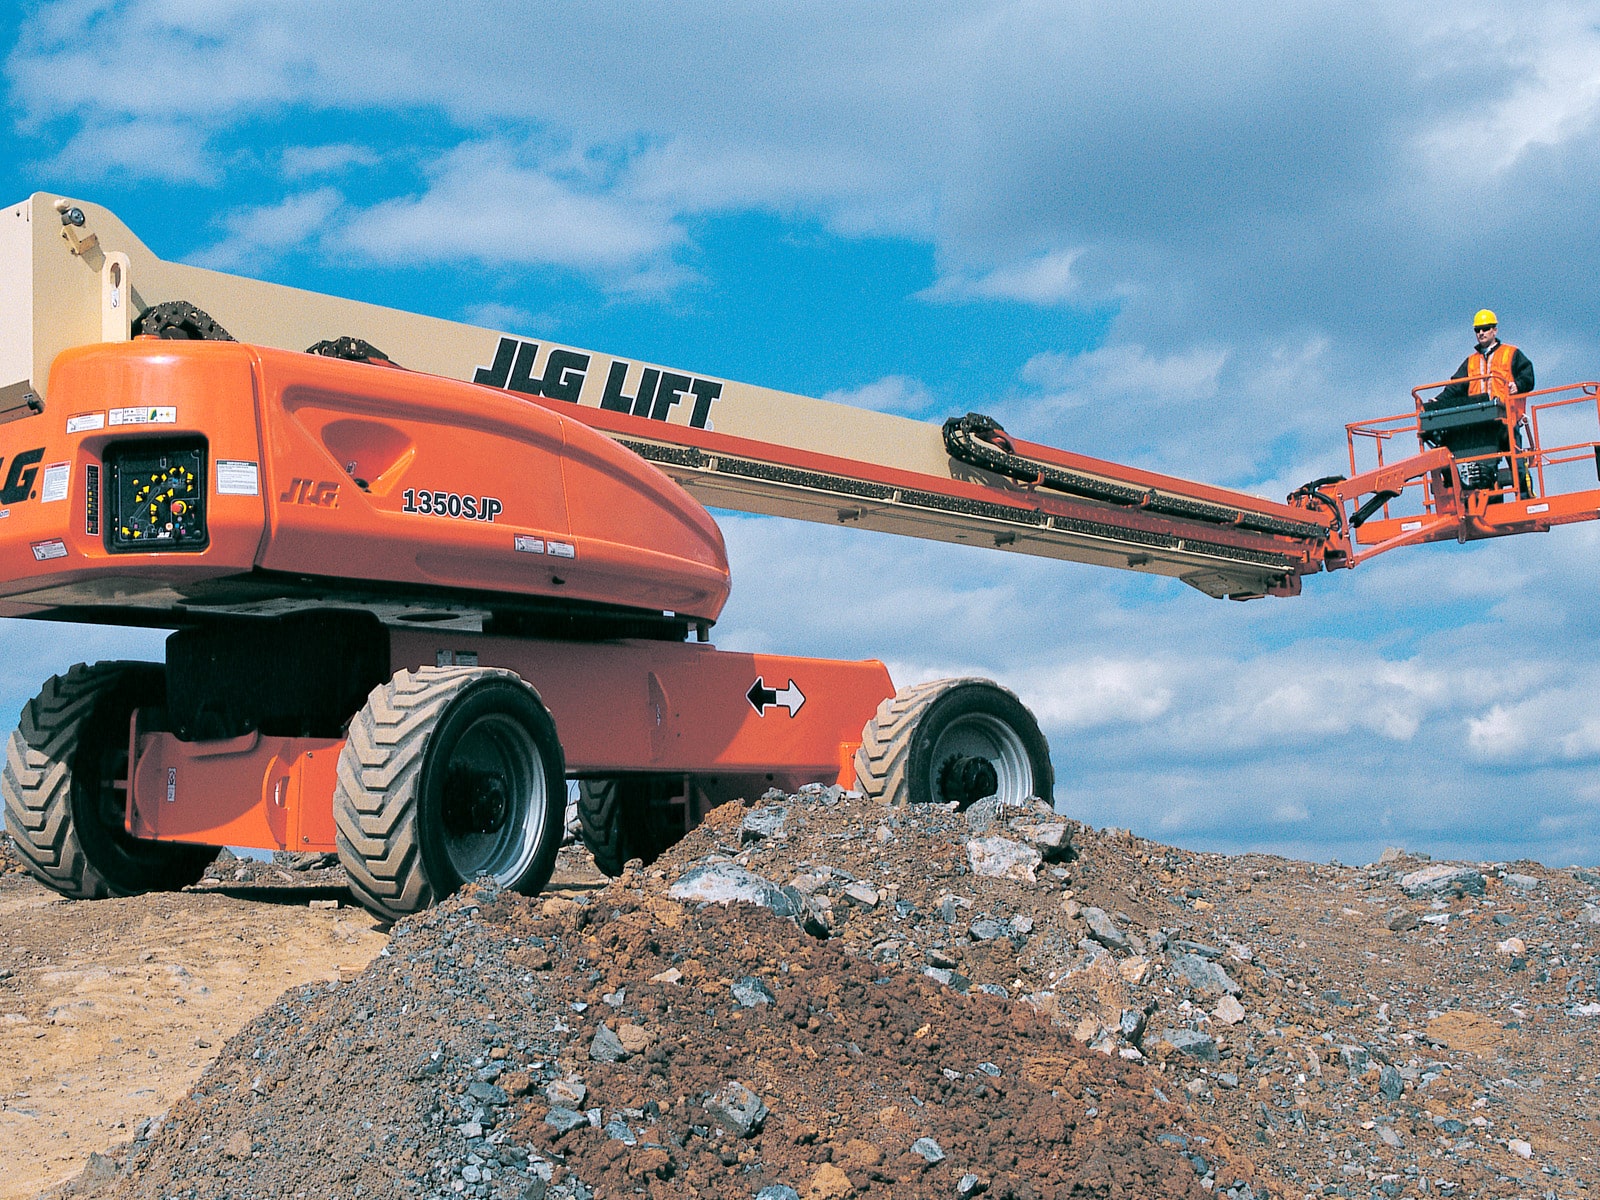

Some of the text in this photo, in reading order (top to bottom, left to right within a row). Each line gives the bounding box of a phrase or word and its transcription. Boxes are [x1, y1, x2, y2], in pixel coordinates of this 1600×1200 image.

[473, 337, 723, 430] JLG LIFT
[0, 446, 46, 505] G
[280, 477, 341, 509] JLG
[403, 488, 502, 522] 1350SJP
